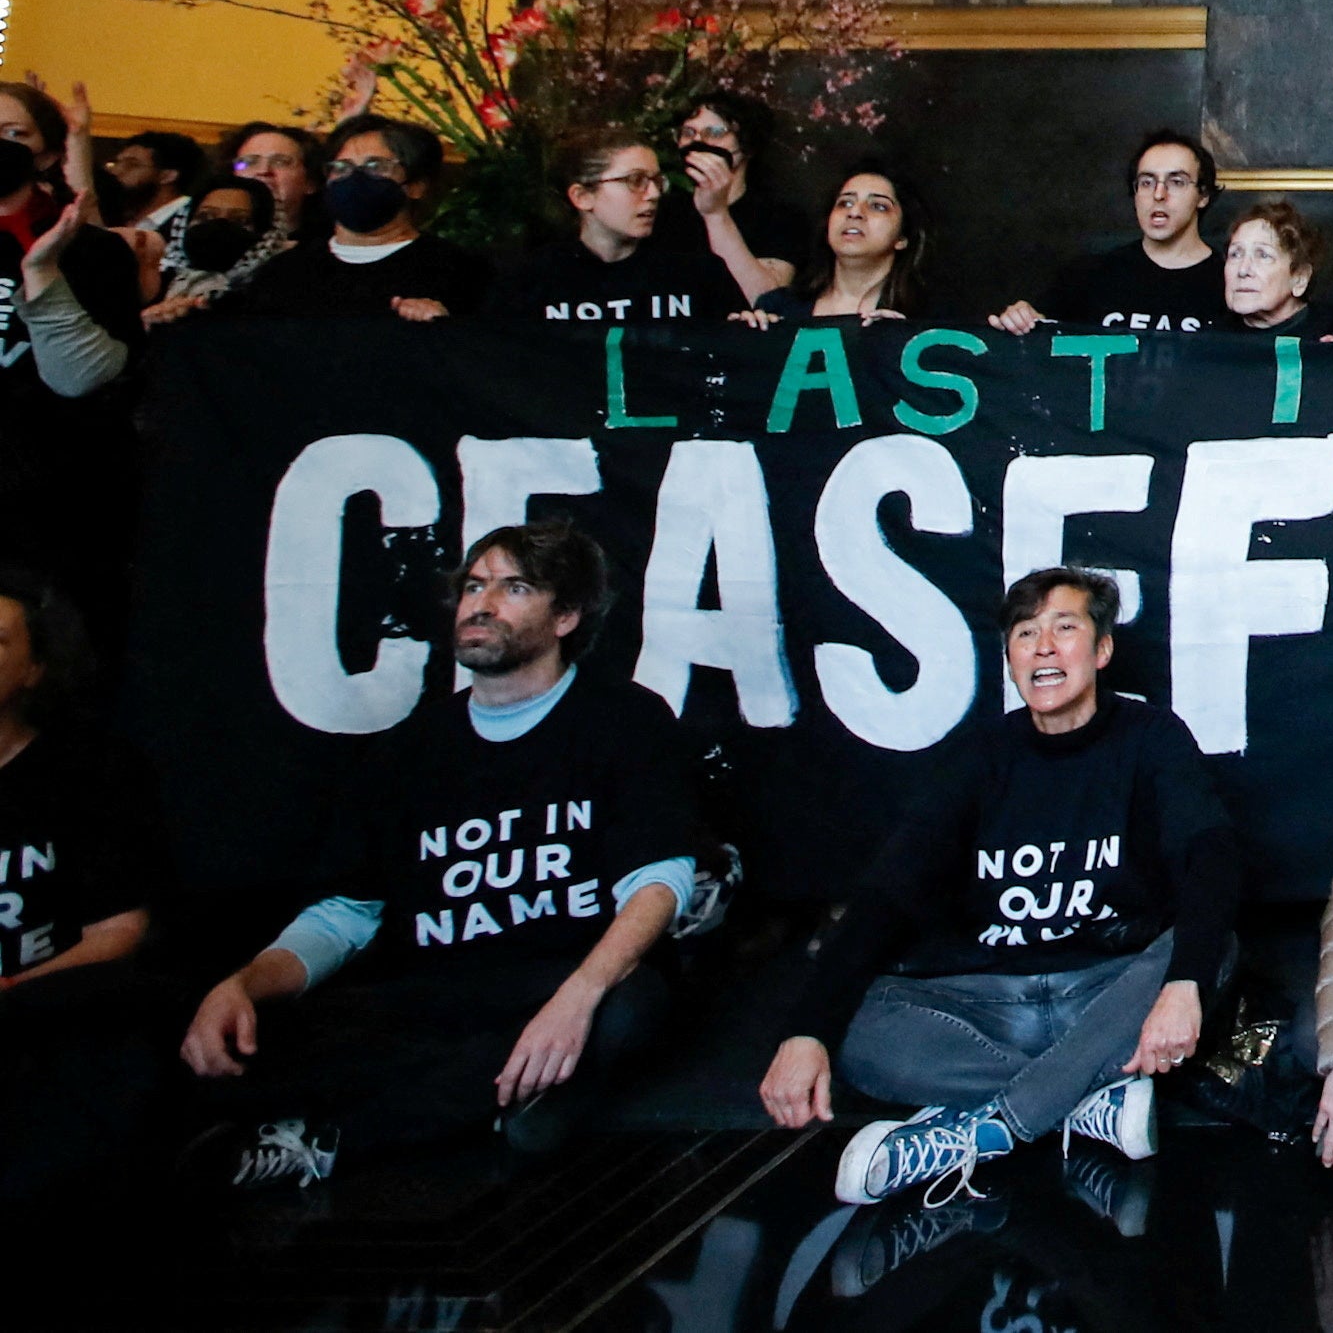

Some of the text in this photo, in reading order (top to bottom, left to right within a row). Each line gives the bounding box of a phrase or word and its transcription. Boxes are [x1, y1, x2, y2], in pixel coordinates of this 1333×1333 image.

[545, 294, 691, 320] NOT IN
[1101, 311, 1212, 332] CEAS
[421, 800, 591, 861] NOT IN
[442, 843, 571, 898] OUR
[977, 835, 1120, 880] NOT IN
[416, 878, 600, 946] NAME
[998, 879, 1094, 921] OUR
